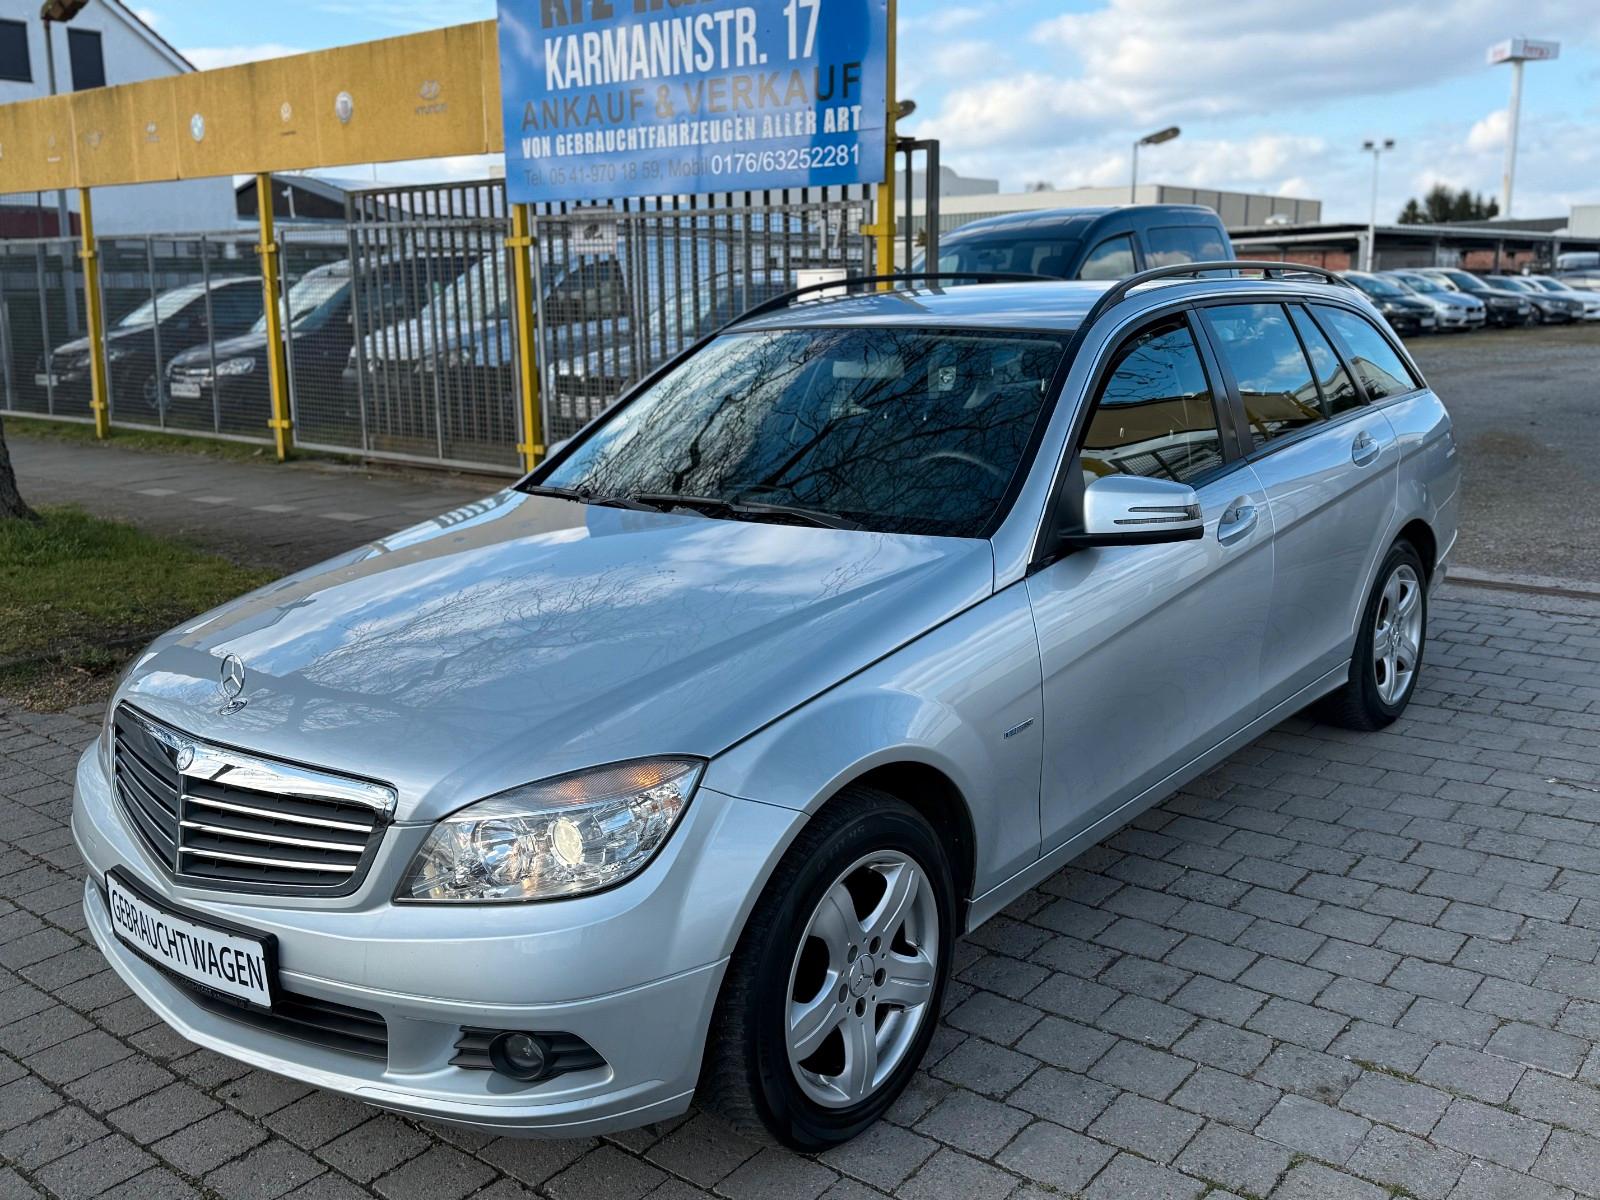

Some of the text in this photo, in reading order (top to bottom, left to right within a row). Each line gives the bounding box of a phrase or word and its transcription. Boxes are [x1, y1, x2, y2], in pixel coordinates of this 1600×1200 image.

[545, 7, 767, 91] KARMANNSTR.
[783, 0, 820, 60] 17
[522, 61, 862, 131] ANKAUF & VERKAUF
[522, 105, 862, 159] VON GEBRAUCHTFAHRZEUGEN ALLER ART
[711, 144, 860, 175] 0176/63252281
[112, 889, 265, 992] GEBRAUCHTWAGEN
